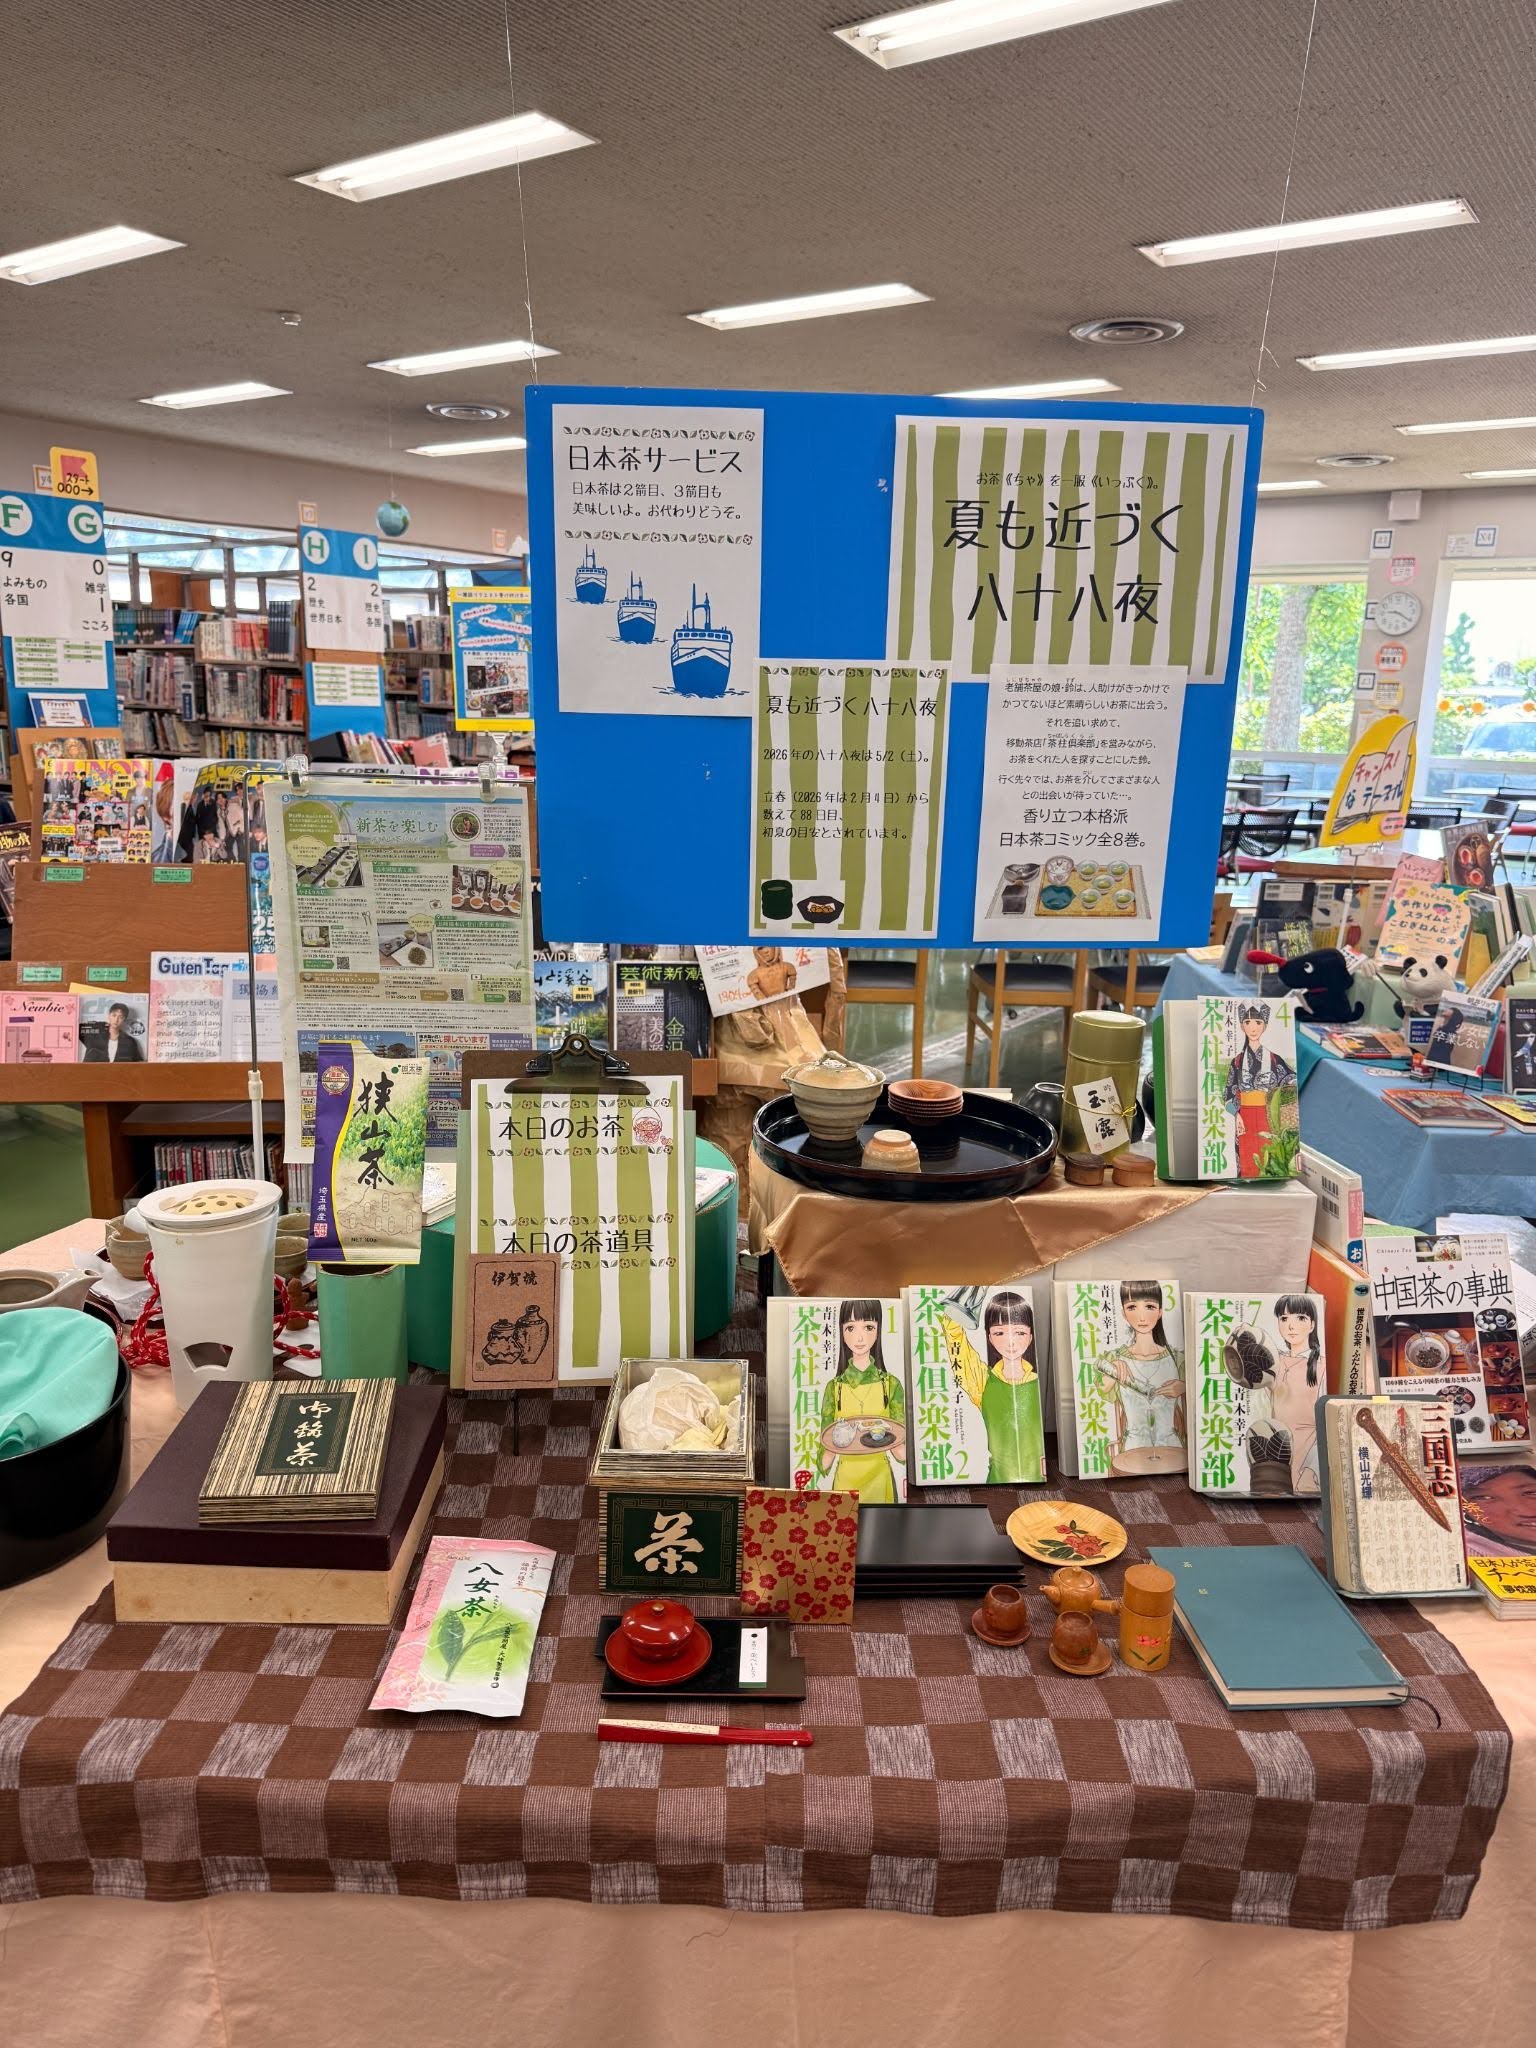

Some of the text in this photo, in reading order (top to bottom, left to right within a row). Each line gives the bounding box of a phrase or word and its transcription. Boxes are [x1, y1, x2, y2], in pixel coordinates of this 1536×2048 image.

[569, 445, 743, 473] 日本茶サービス
[66, 472, 90, 484] スタート
[1, 503, 24, 529] F
[572, 501, 742, 520] 美味しいよ。お代わりどうぞ。
[73, 512, 98, 537] G
[943, 499, 1184, 553] 夏も近づく
[307, 536, 325, 559] H
[2, 576, 48, 589] よみもの
[85, 581, 107, 594] 雑学
[307, 576, 317, 591] 2
[370, 583, 380, 597] 2
[5, 593, 29, 606] 各国
[967, 572, 1163, 624] 八十八夜
[82, 620, 110, 632] こころ
[309, 612, 343, 624] 世界日本
[765, 695, 938, 717] 夏も近づく八十八夜
[1002, 698, 1169, 711] かつてないほど素晴らしいお茶に出会う。
[1046, 717, 1121, 728] それを追い求めて、
[1009, 754, 1152, 766] お茶をくれた人を探すことにした鈴。
[998, 773, 1160, 785] 行く先々では、お茶を介してさまざまな人
[356, 817, 438, 834] 新茶を楽しむ
[1023, 808, 1129, 825] 香り立つ本格派
[762, 827, 907, 840] 初夏の目安とされています。
[999, 832, 1147, 848] 日本茶コミック全8巻。
[158, 957, 202, 975] Guten
[1225, 1000, 1234, 1057] 青木幸子
[1275, 1002, 1292, 1028] 4
[1201, 998, 1228, 1175] 茶柱倶楽部
[353, 1071, 398, 1190] 狭山茶
[498, 1114, 626, 1141] 本日のお茶
[501, 1228, 656, 1255] 本日の茶道具
[1162, 1284, 1176, 1313] 3
[1374, 1269, 1513, 1311] 中国茶の事典
[887, 1306, 898, 1334] 1
[1101, 1284, 1113, 1346] 青木幸子
[1247, 1300, 1262, 1327] 7
[822, 1306, 832, 1371] 青木幸子
[913, 1287, 954, 1482] 茶柱倶楽部
[950, 1341, 964, 1405] 青木幸子
[1073, 1283, 1110, 1475] 茶柱倶楽部
[1198, 1298, 1236, 1489] 茶柱倶楽部
[1233, 1387, 1247, 1448] 青木幸子
[1421, 1404, 1456, 1497] 三国志
[955, 1450, 970, 1480] 2
[1358, 1446, 1373, 1499] 横山光輝
[634, 1511, 704, 1575] 茶
[455, 1562, 504, 1618] 八女茶
